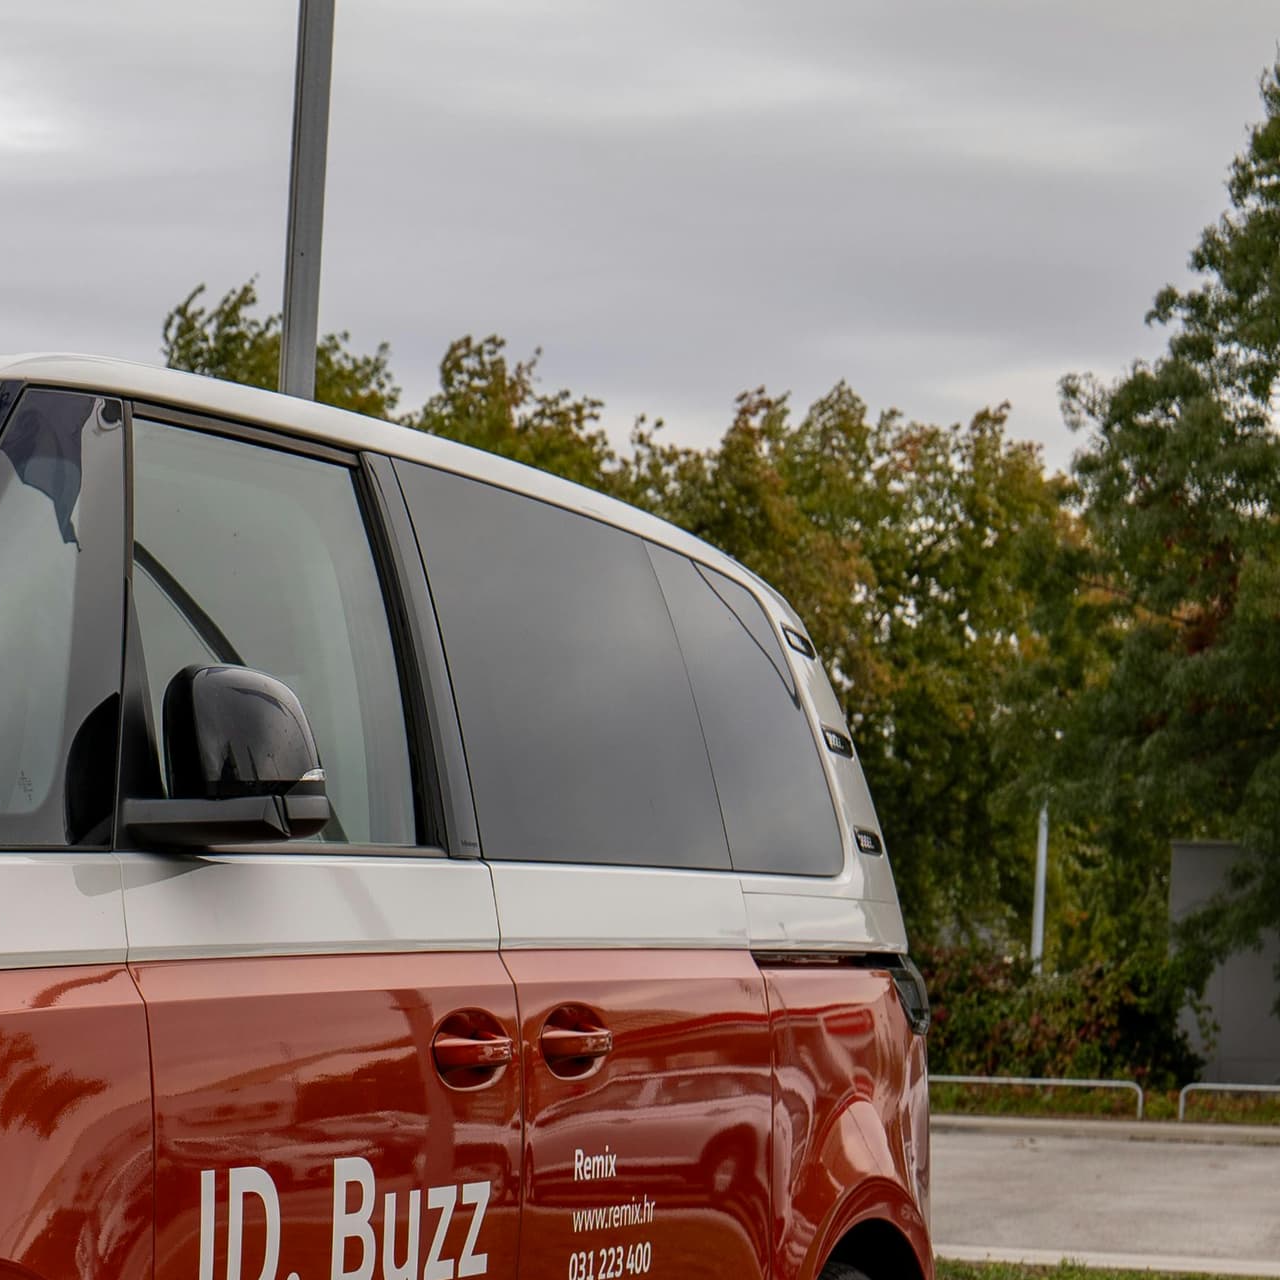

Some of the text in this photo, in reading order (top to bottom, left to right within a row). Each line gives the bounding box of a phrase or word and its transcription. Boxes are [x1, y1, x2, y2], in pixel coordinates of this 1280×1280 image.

[574, 1145, 617, 1182] Remix
[572, 1194, 656, 1234] www.remix.hr
[626, 1242, 652, 1275] 400
